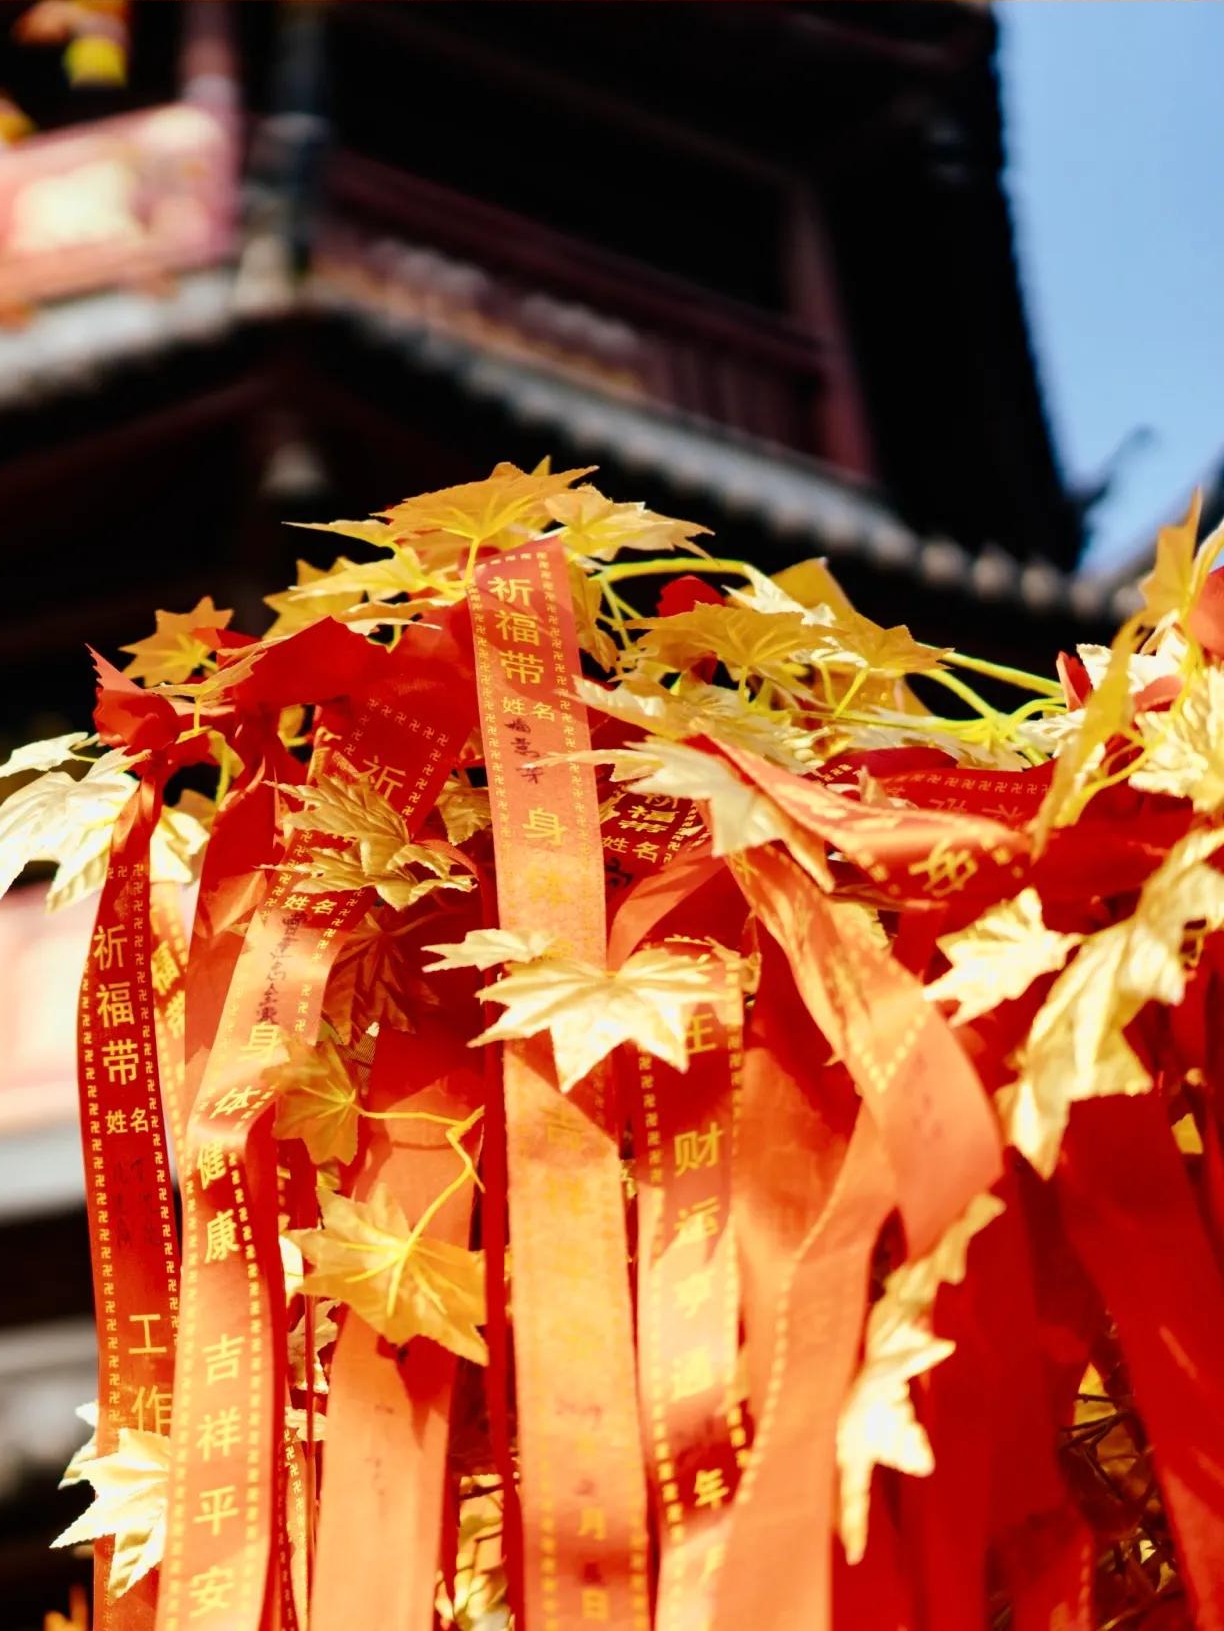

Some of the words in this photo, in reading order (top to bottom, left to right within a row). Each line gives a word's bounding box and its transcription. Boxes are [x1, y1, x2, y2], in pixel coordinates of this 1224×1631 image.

[487, 576, 545, 685] 祈福带
[501, 697, 557, 722] 姓名
[602, 836, 660, 863] 姓名
[281, 894, 338, 916] 姓名
[92, 924, 139, 1088] 祈福带
[105, 1109, 151, 1135] 姓名
[189, 1333, 247, 1618] 吉祥平安
